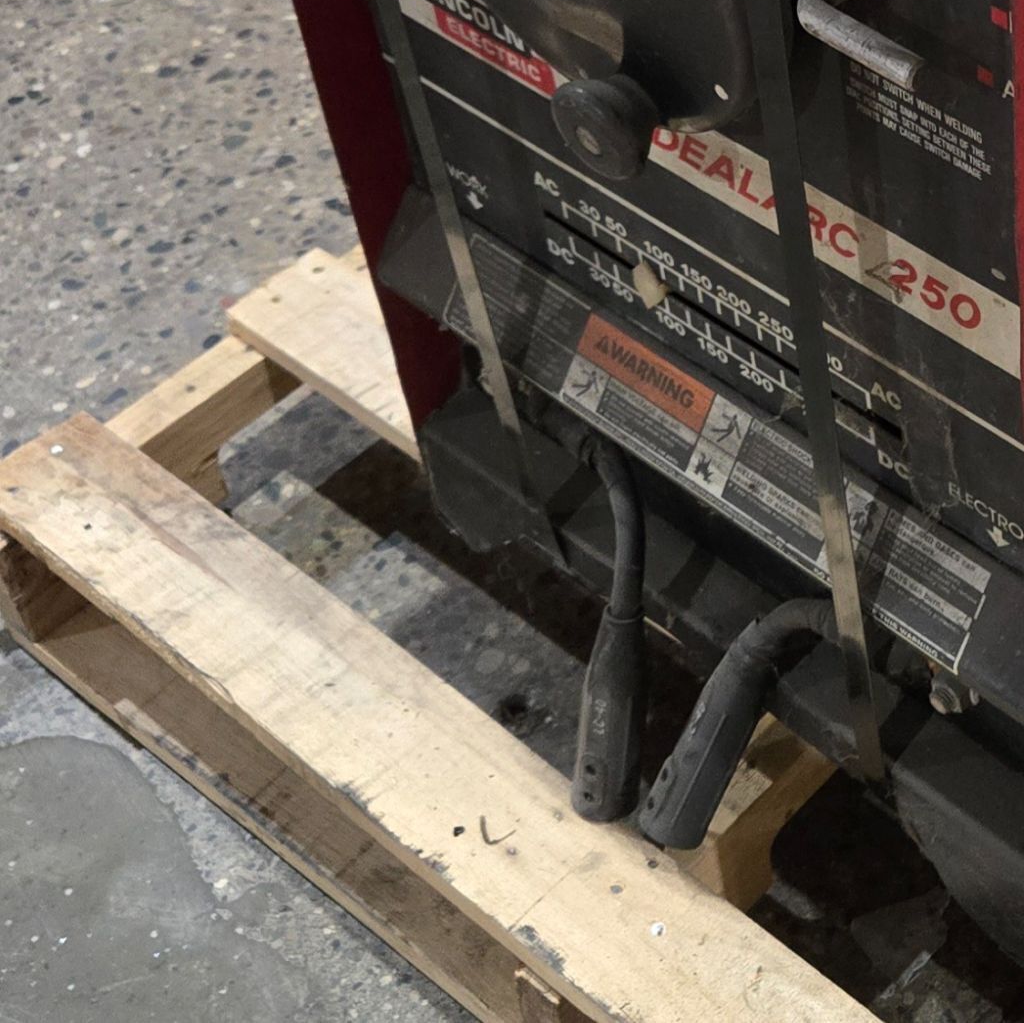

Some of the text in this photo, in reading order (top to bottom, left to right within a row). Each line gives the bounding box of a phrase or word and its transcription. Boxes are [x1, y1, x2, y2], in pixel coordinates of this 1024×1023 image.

[447, 16, 542, 83] ELECTRIC
[878, 92, 896, 111] MUST
[900, 104, 918, 123] SNAP
[920, 116, 936, 133] INTO
[939, 126, 957, 145] EACH
[959, 139, 968, 151] OF
[970, 144, 985, 161] THE
[882, 78, 912, 106] SWITCH
[916, 97, 941, 122] WHEN
[944, 112, 982, 145] WELDING
[882, 116, 896, 132] MAY
[899, 126, 922, 147] CAUSE
[924, 139, 950, 164] SWITCH
[953, 156, 982, 182] DAMAGE
[902, 117, 930, 141] SETTING
[933, 134, 965, 161] BETWEEN
[968, 154, 990, 175] THESE
[534, 171, 794, 341] AC 30 50 100 150 200 250
[547, 238, 774, 393] DC 30 50 100 150 200
[889, 258, 982, 329] 250
[609, 339, 695, 409] WARNING
[871, 381, 902, 410] AC
[878, 449, 912, 480] DC
